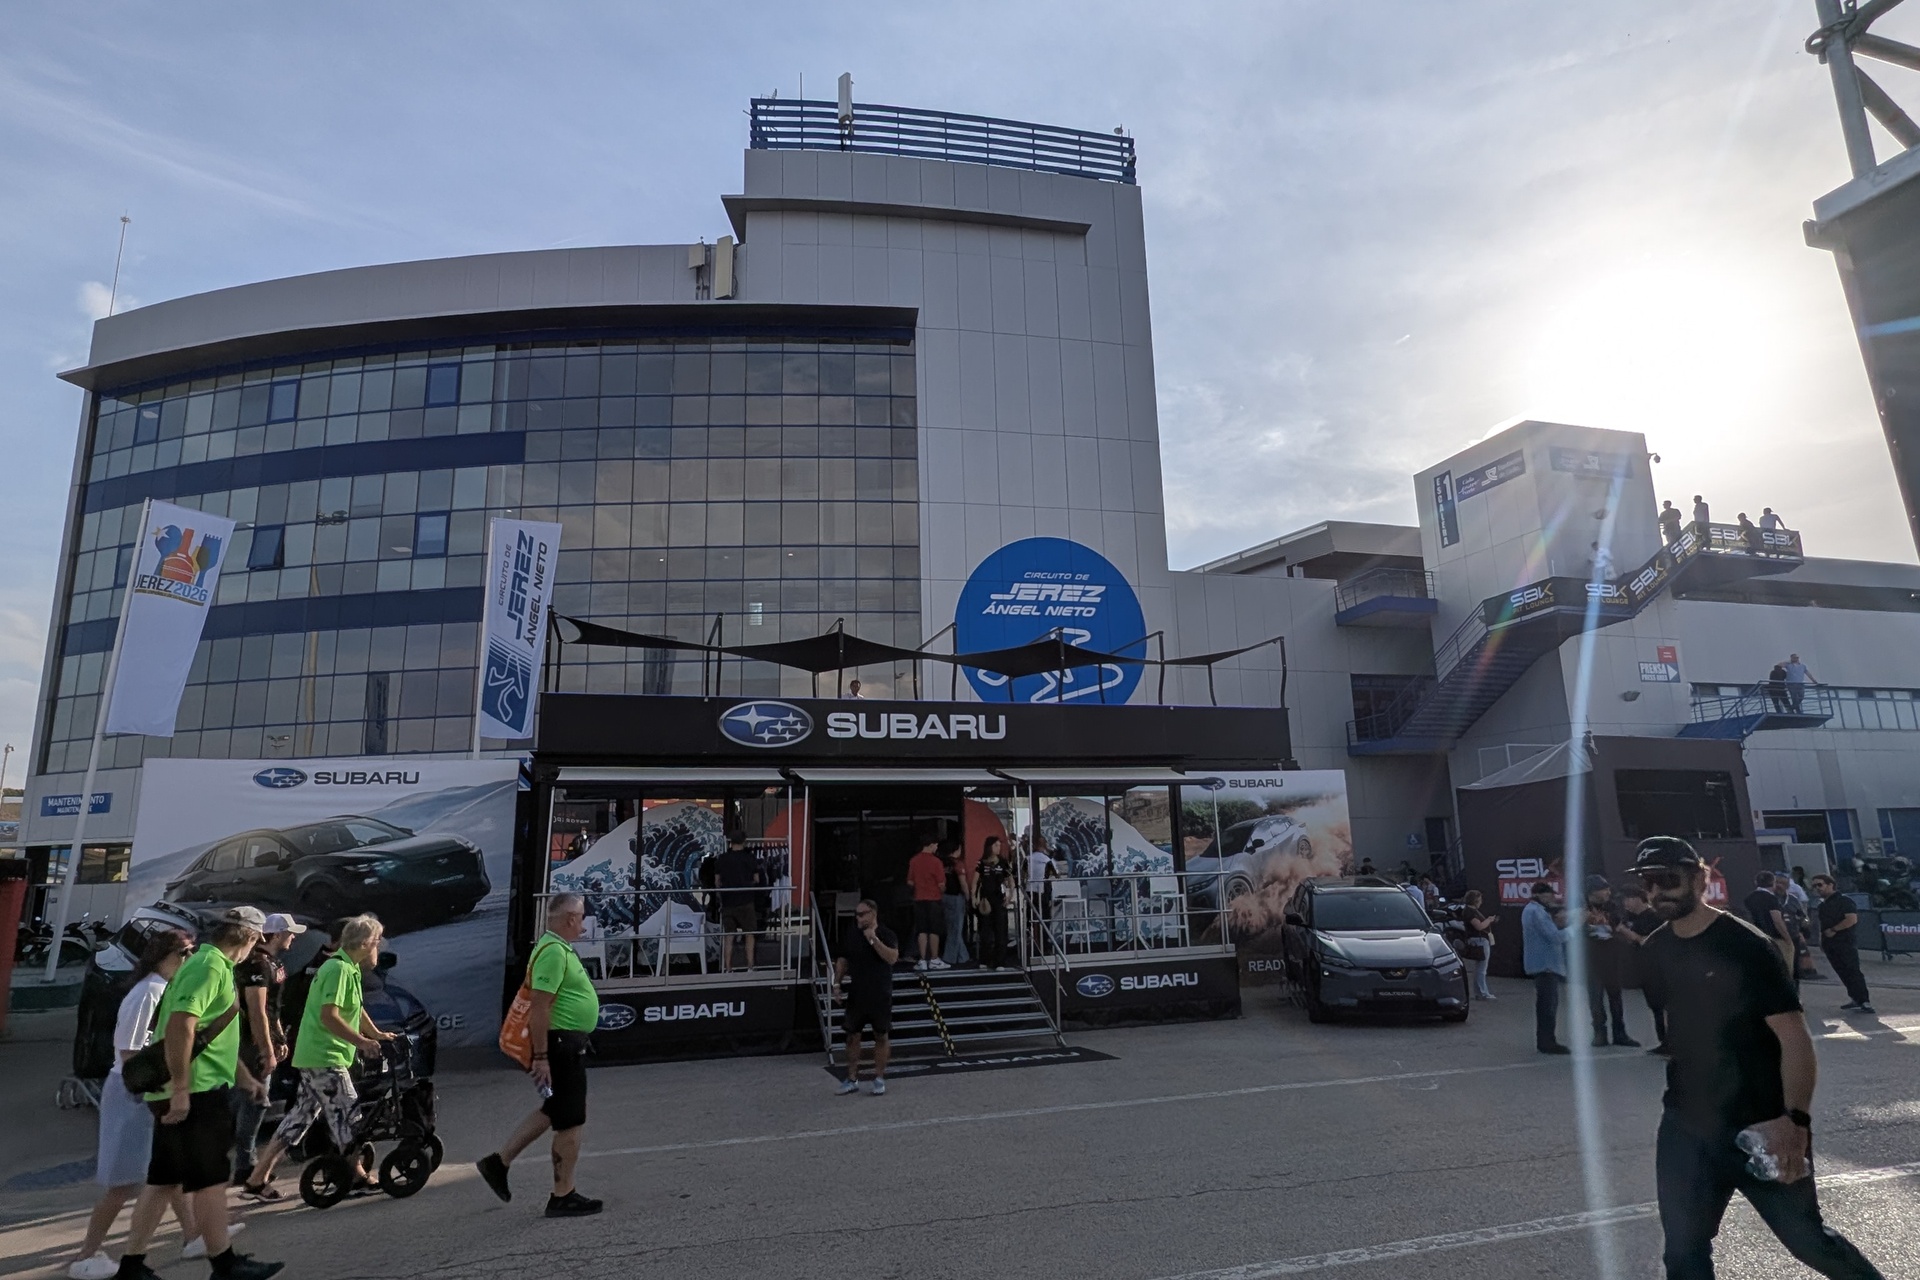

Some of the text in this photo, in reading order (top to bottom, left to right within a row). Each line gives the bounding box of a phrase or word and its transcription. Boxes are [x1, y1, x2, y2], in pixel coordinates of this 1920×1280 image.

[1443, 474, 1452, 501] 1
[1436, 477, 1449, 546] ESCALERA
[1709, 527, 1749, 541] SBK
[498, 544, 512, 606] CIRCUITO DE
[506, 529, 535, 640] JEREZ
[1023, 571, 1090, 581] CIRCUITO DE
[1629, 559, 1664, 596] SBK
[522, 541, 548, 649] ÁNGEL NIETO
[989, 582, 1107, 603] JEREZ
[1510, 582, 1554, 608] SBK
[1584, 583, 1628, 598] SBK
[981, 601, 1097, 618] ÁNGEL NIETO
[827, 712, 1007, 740] SUBARU
[313, 771, 420, 785] SUBARU
[1228, 778, 1284, 788] SUBARU
[1502, 881, 1563, 899] MOL
[1120, 972, 1199, 990] SUBARU
[643, 1000, 746, 1022] SUBARU
[936, 1050, 1081, 1068] SUBARU
